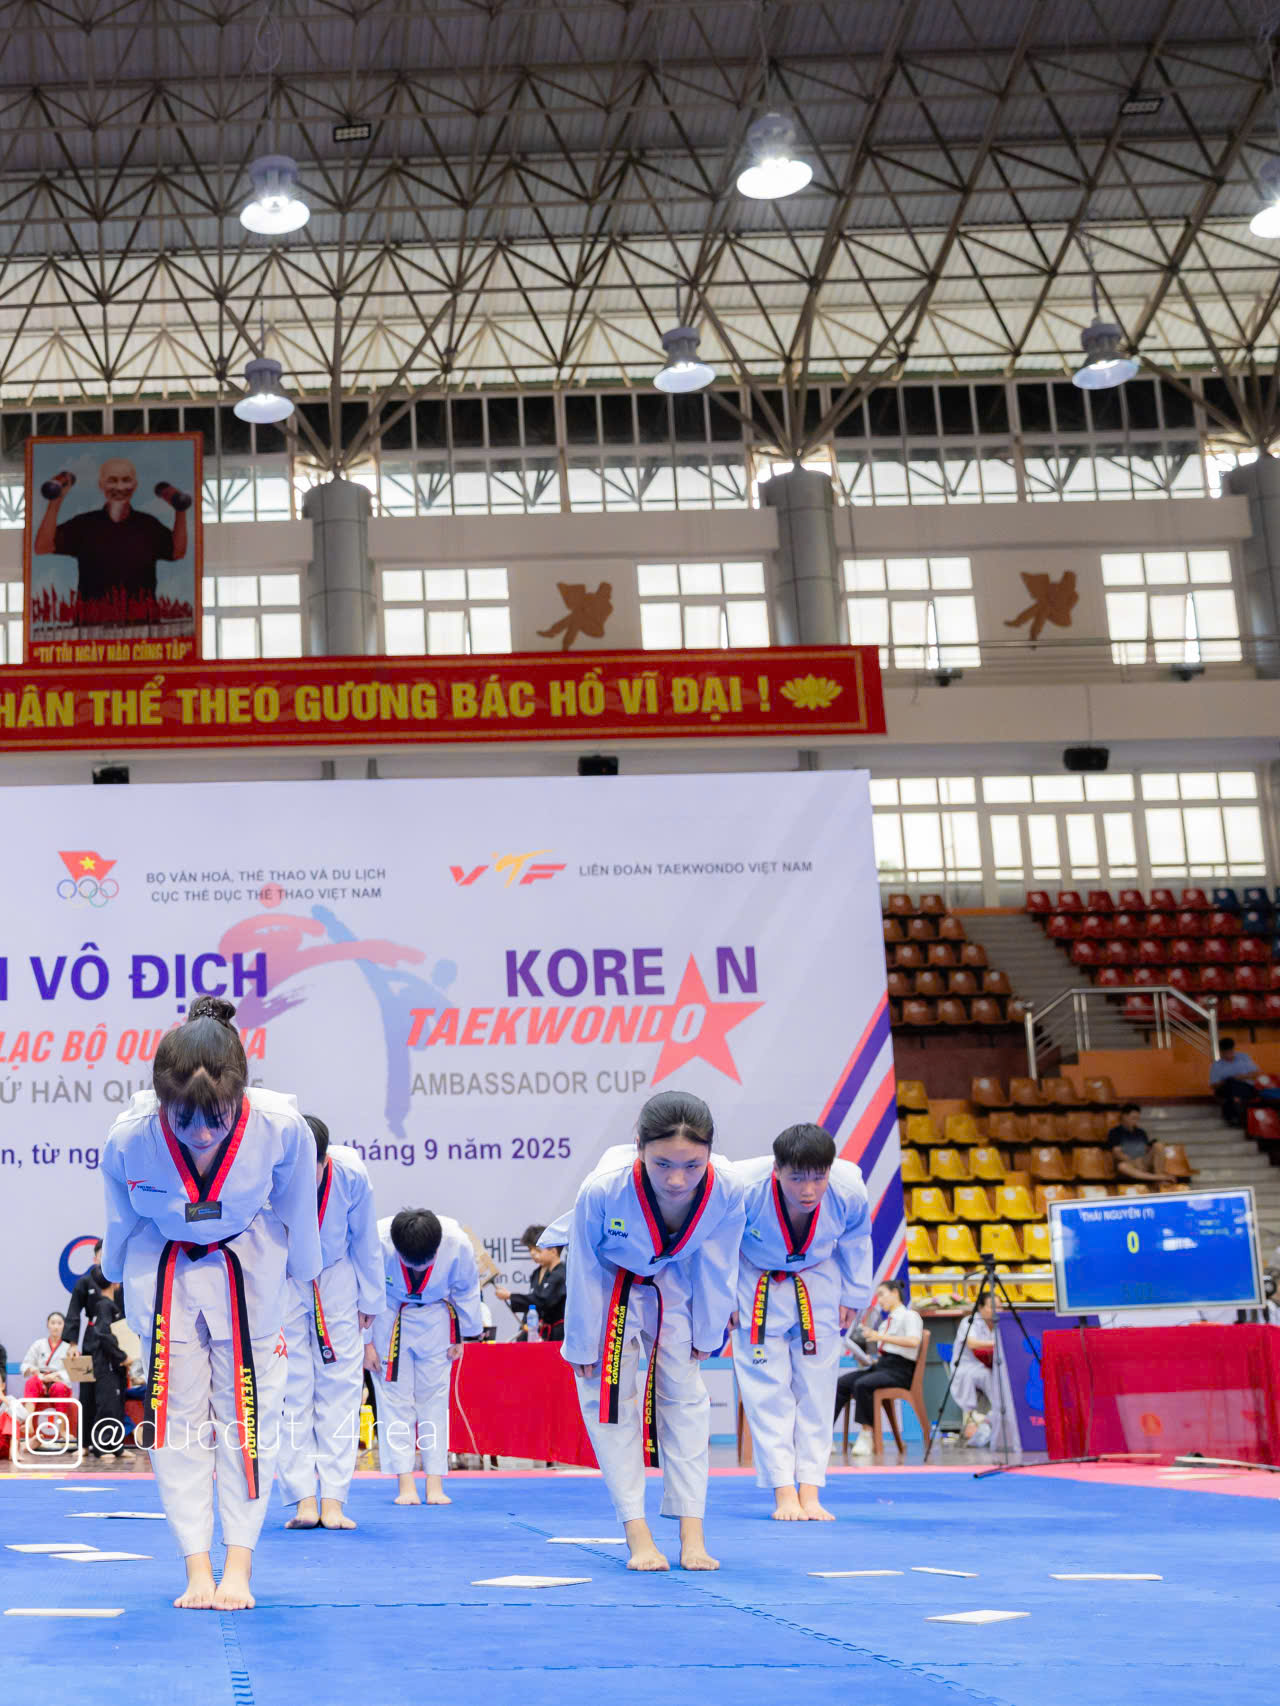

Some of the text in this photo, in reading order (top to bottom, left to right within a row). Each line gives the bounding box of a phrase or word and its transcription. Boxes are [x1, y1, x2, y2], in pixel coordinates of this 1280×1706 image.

[88, 675, 165, 727] THỂ
[177, 685, 281, 726] THEO
[295, 681, 439, 722] GƯƠNG
[452, 676, 536, 720] BÁC
[550, 667, 607, 718] HỒ
[619, 673, 661, 715] VĨ
[671, 675, 744, 722] ĐẠI
[758, 675, 772, 713] !
[269, 869, 307, 881] THAO
[310, 868, 329, 881] VÀ
[332, 869, 352, 881] DU
[355, 868, 386, 883] LỊCH
[579, 860, 813, 877] LIÊN ĐOÀN TAEKWONDO VIỆT NAM
[151, 891, 176, 904] CỤC
[214, 890, 243, 904] DỤC
[278, 888, 314, 900] THAO
[318, 886, 348, 902] VIỆT
[352, 888, 382, 899] NAM
[30, 942, 110, 1001] VÔ
[129, 952, 268, 1014] ĐỊCH
[407, 1003, 706, 1047] TAEKWONDO
[62, 1022, 108, 1070] BỘ
[30, 1074, 93, 1104] HÀN
[411, 1068, 647, 1098] AMBASSADOR CUP
[32, 1142, 60, 1165] từ
[424, 1139, 439, 1161] 9
[448, 1138, 503, 1161] năm
[511, 1137, 572, 1160] 2025
[1126, 1231, 1140, 1254] 0
[617, 1306, 626, 1335] WORLD
[612, 1335, 623, 1384] TAEKWONDO
